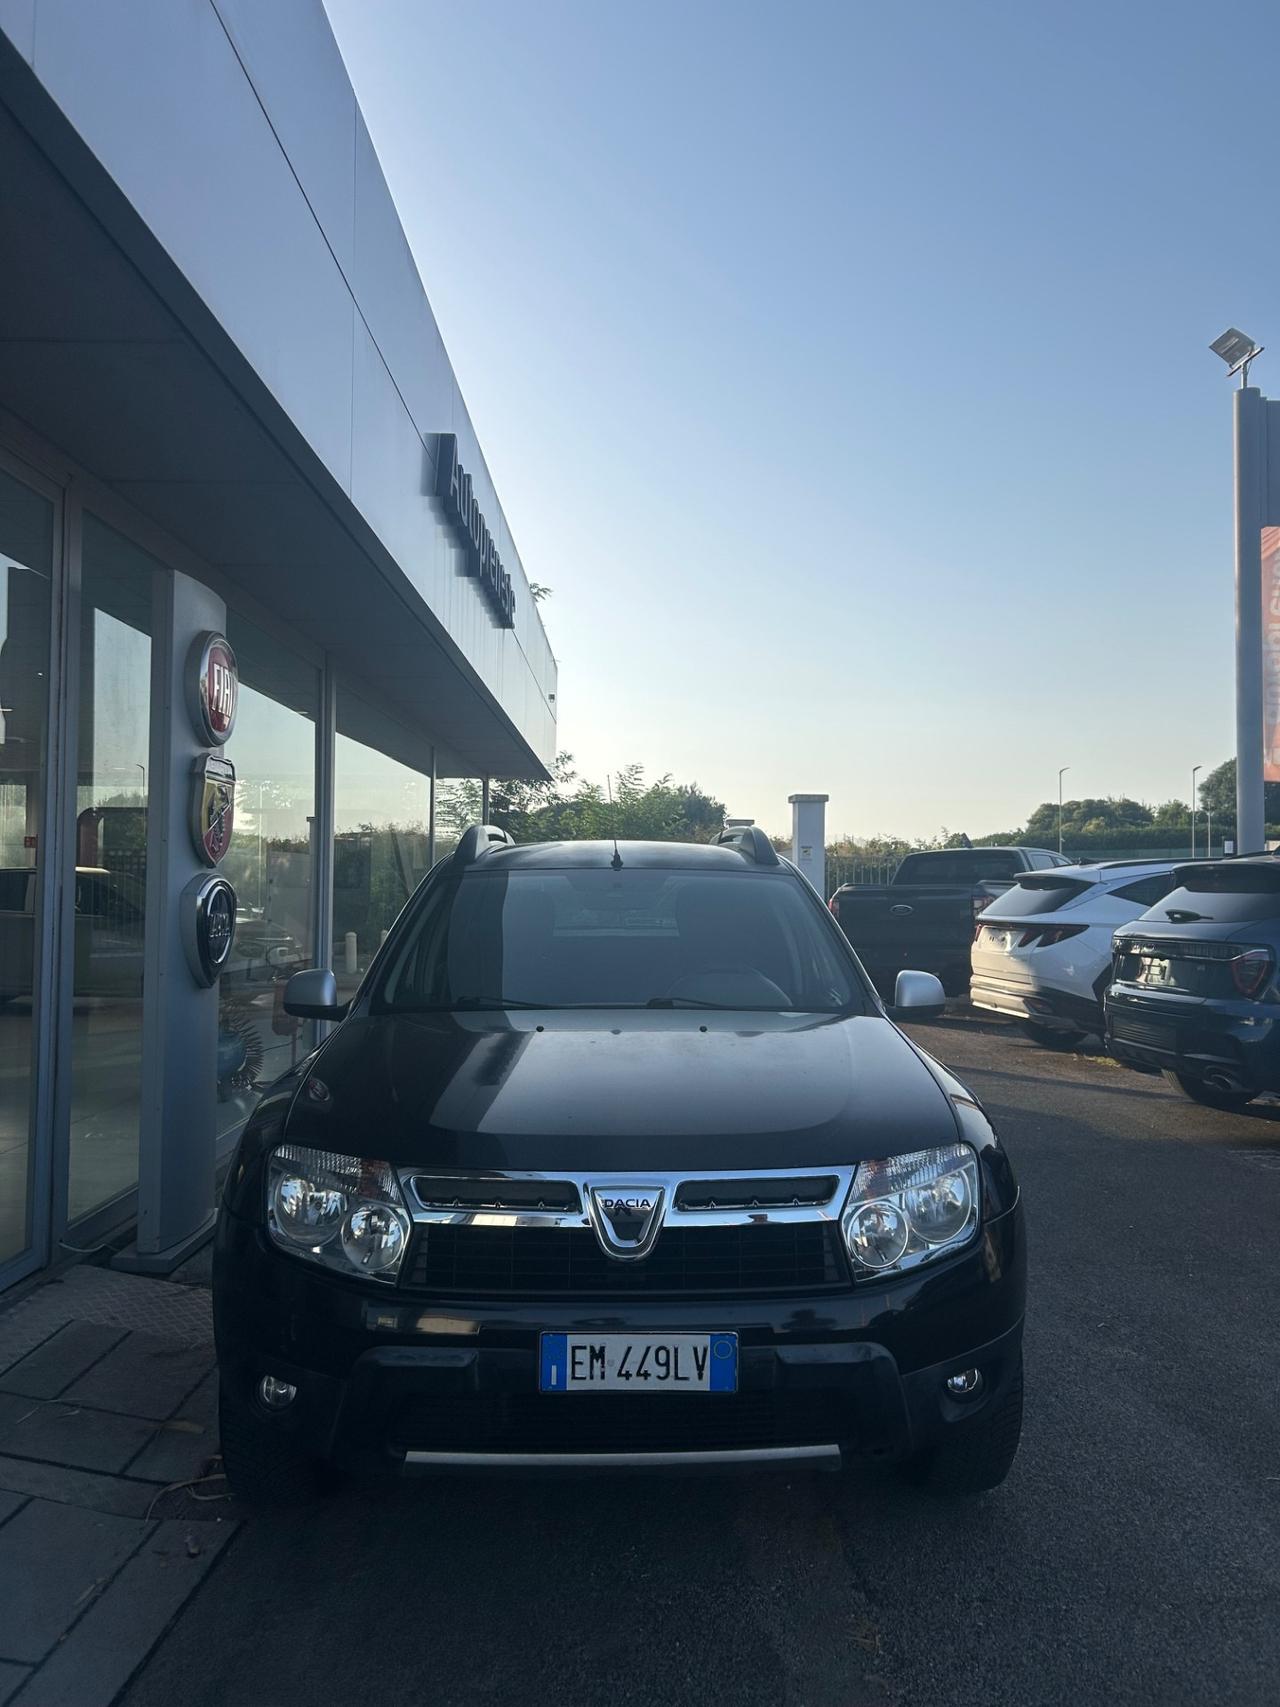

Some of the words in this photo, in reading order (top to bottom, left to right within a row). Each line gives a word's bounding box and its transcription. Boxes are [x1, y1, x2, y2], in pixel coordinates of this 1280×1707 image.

[603, 1199, 651, 1208] DACIA
[570, 1345, 606, 1381] EM
[617, 1345, 708, 1381] 449LV
